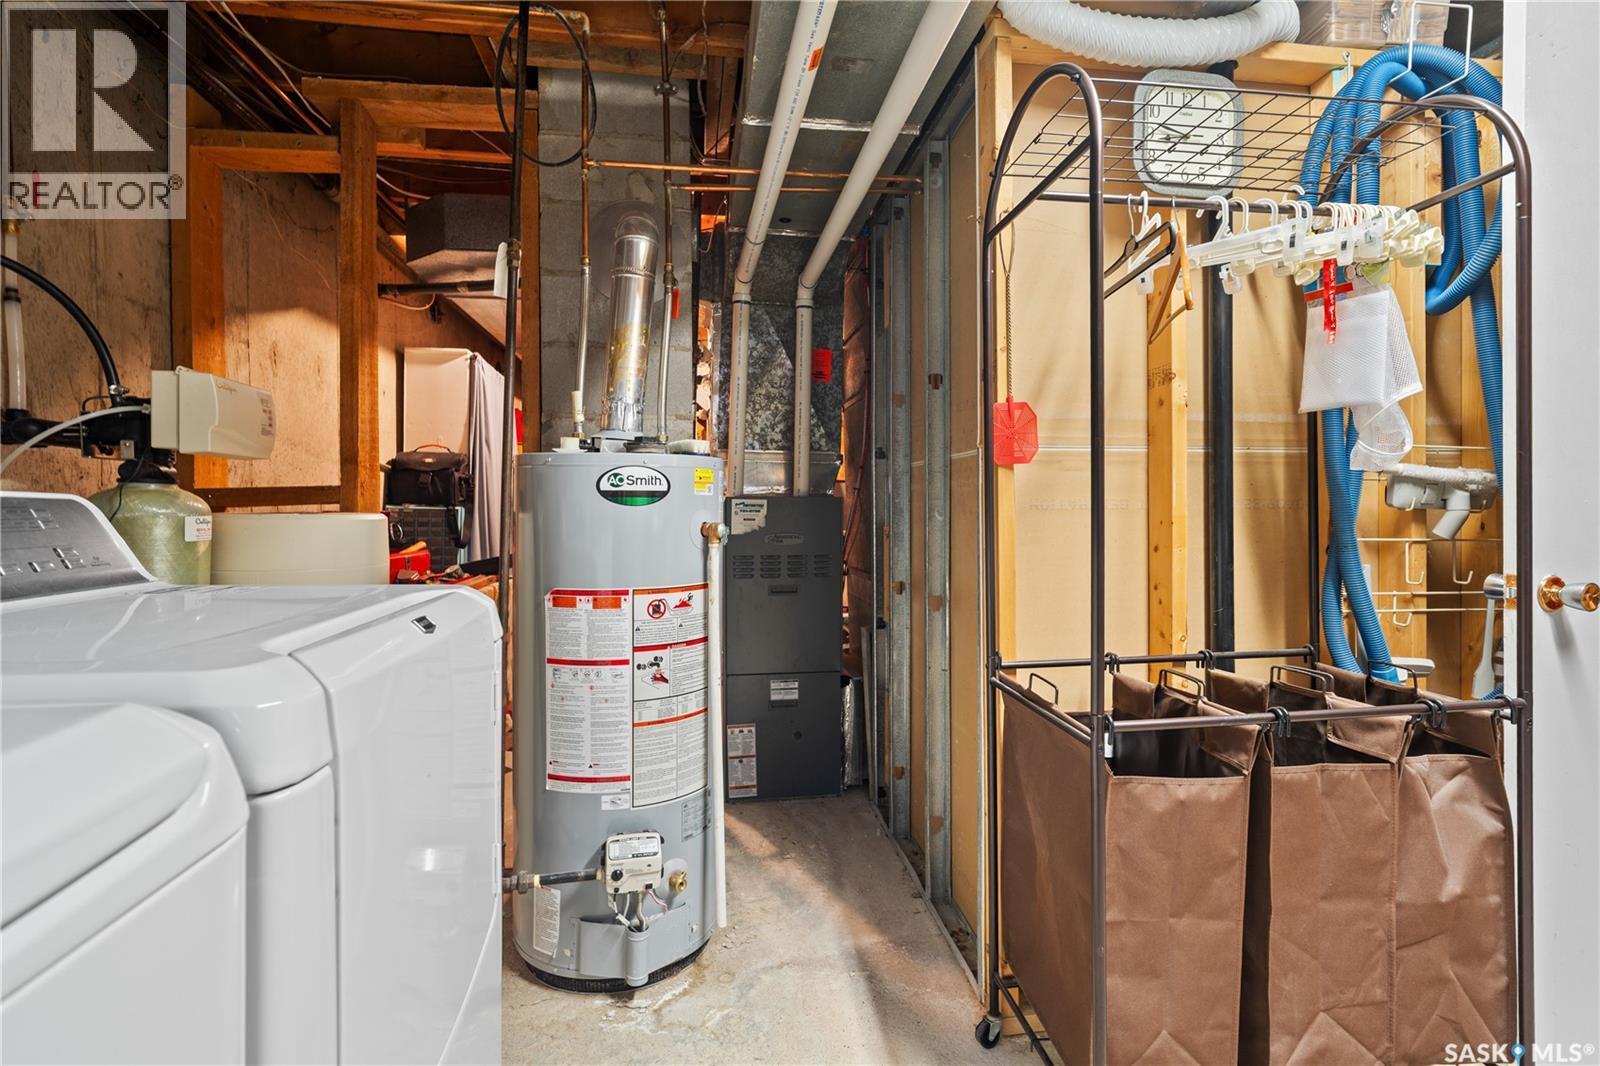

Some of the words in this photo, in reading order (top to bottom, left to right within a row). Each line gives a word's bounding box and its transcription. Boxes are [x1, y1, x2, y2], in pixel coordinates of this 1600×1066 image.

[1166, 91, 1174, 105] 11
[1182, 91, 1193, 107] 12
[1149, 104, 1160, 119] 10
[1215, 108, 1223, 123] 2
[1216, 132, 1224, 147] 3
[1165, 163, 1173, 176] 7
[1181, 166, 1189, 182] 6
[626, 474, 662, 486] Smith
